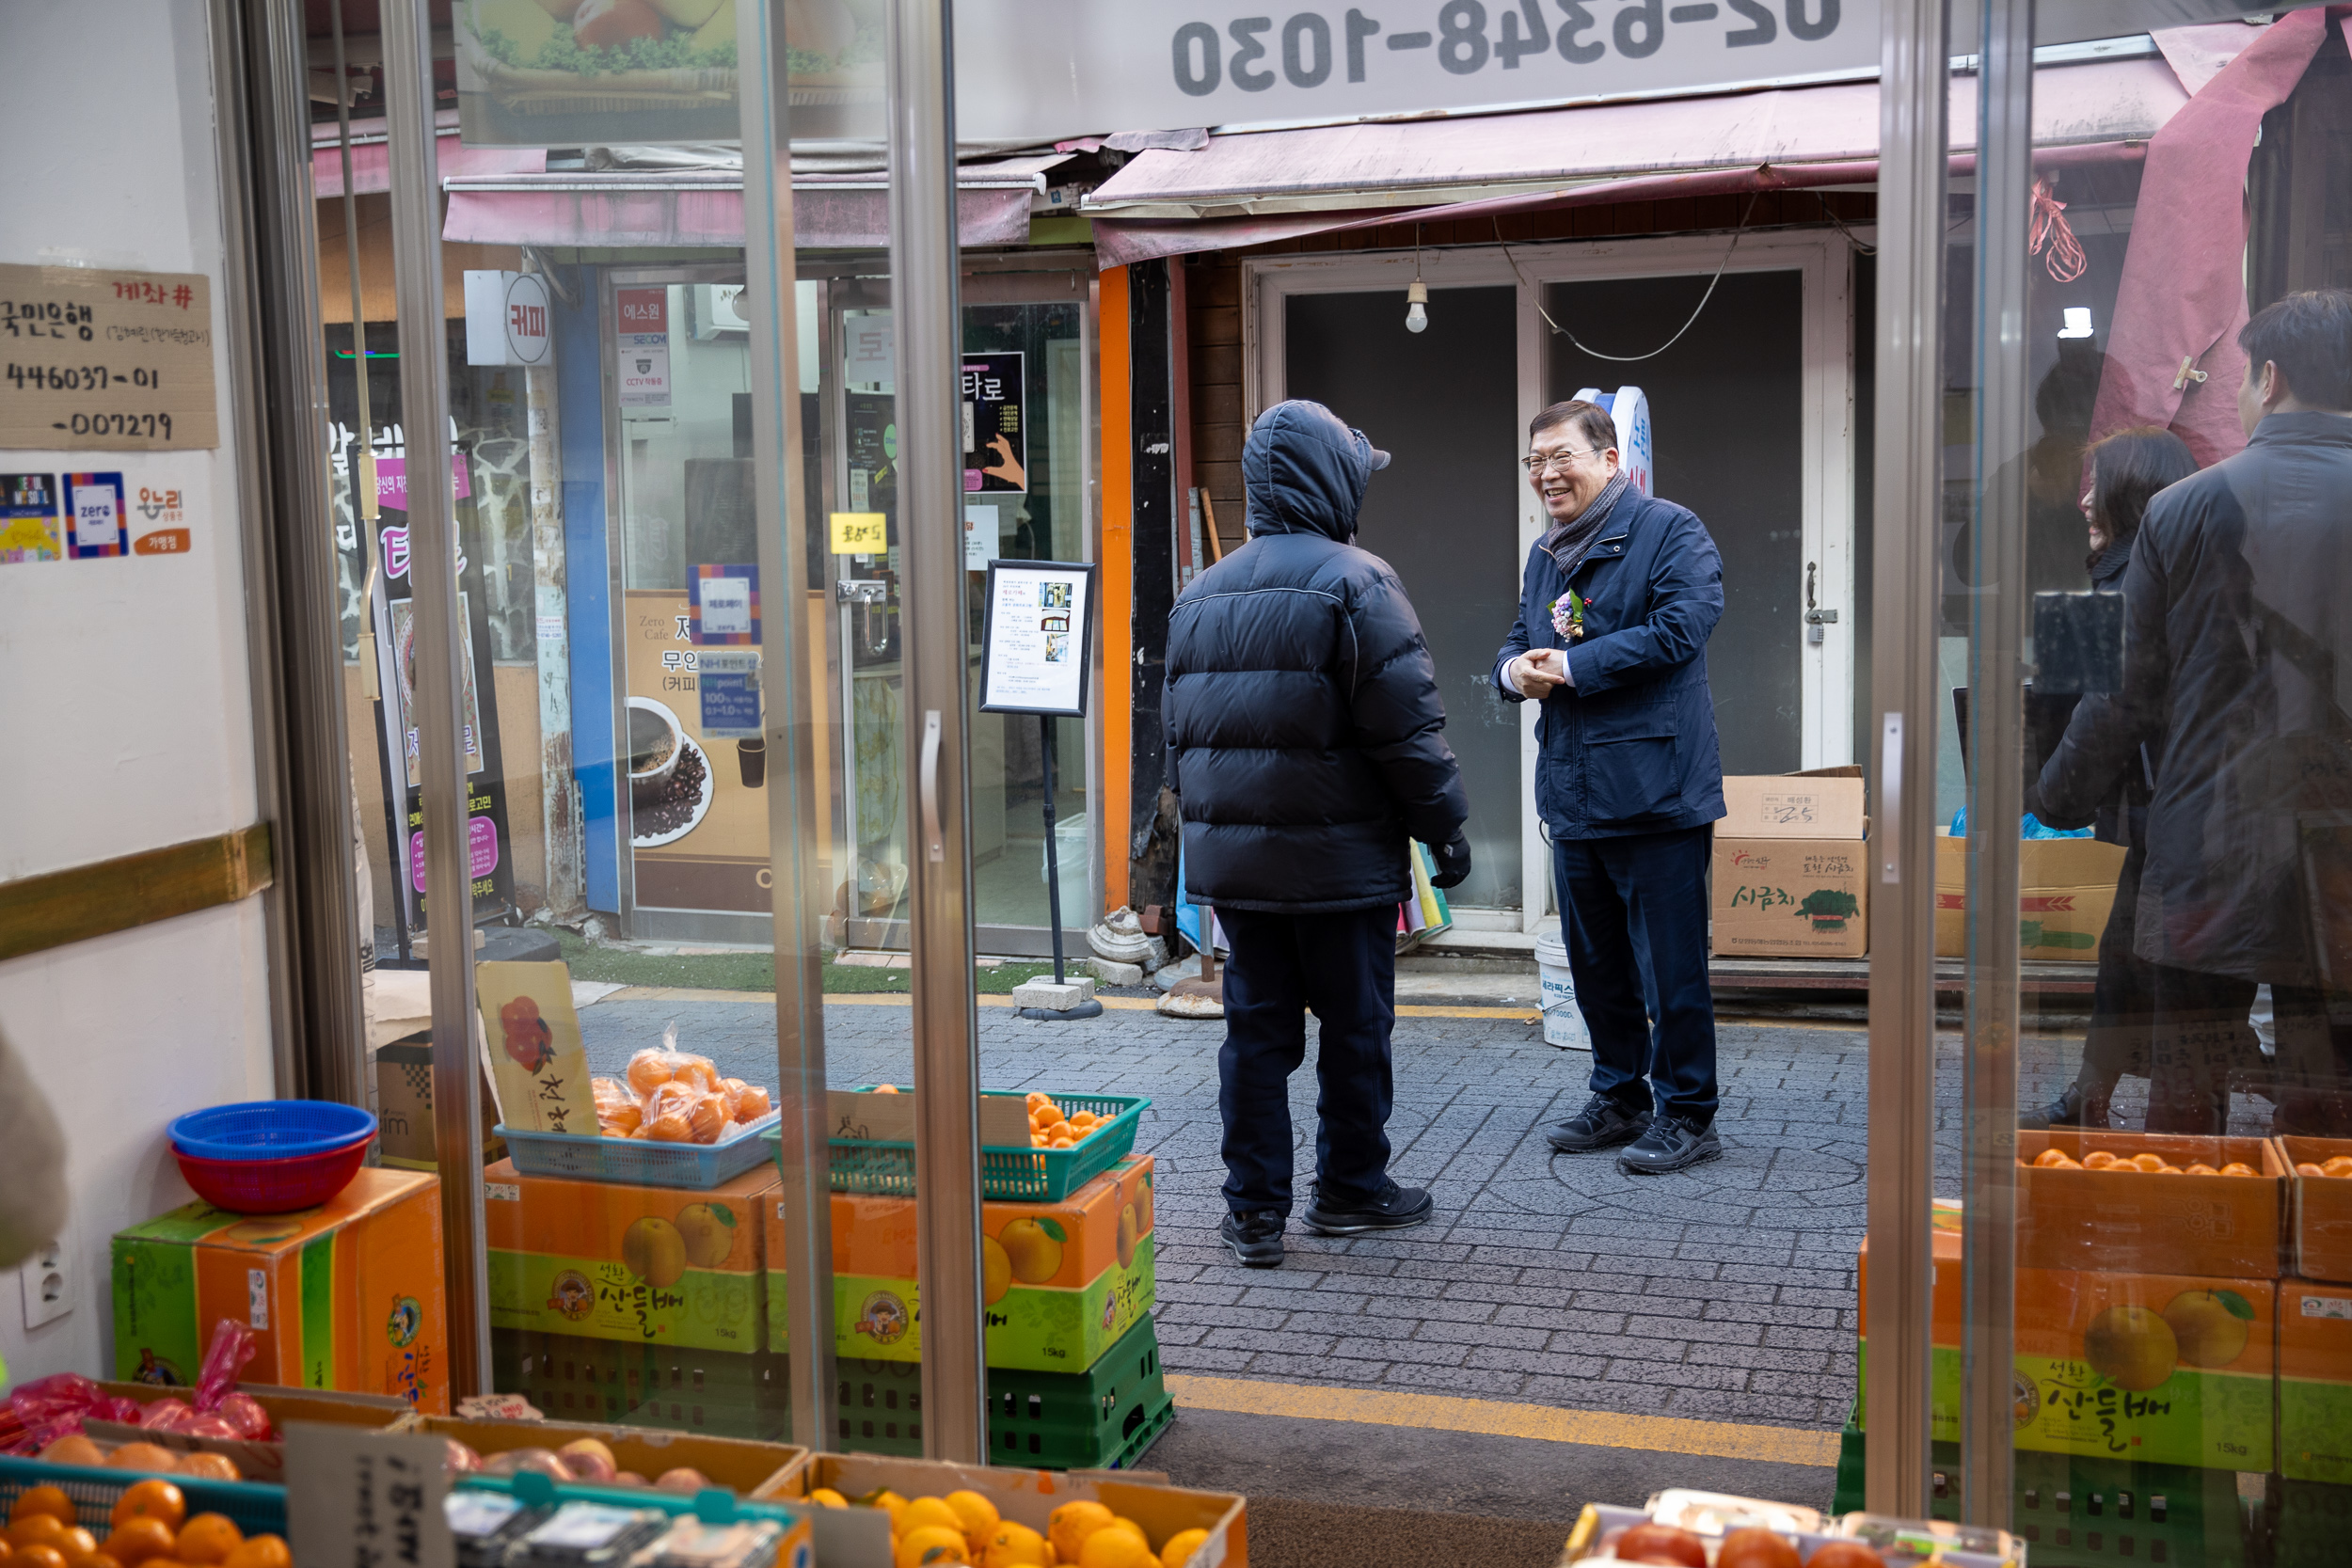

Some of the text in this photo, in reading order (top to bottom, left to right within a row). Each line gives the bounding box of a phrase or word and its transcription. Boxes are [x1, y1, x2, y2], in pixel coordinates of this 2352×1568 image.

[112, 281, 168, 304] 계좌
[624, 304, 660, 320] 에스원
[1, 302, 93, 341] 국민은행
[511, 305, 546, 338] 커피
[634, 334, 667, 344] SECOM
[8, 363, 158, 390] 446037-01
[626, 377, 644, 387] CCTV
[961, 372, 1006, 401] 타로
[52, 413, 173, 440] -007279
[18, 476, 42, 490] SEOUL
[27, 490, 49, 504] SOUL
[81, 505, 110, 517] zero
[149, 536, 177, 550] 가맹점
[708, 599, 743, 610] 제로페이
[640, 615, 665, 627] Zero
[644, 628, 669, 641] Cafe
[1731, 886, 1794, 911] 시금치
[600, 1263, 626, 1281] 성환
[599, 1286, 684, 1338] 산들배
[715, 1328, 737, 1339] 15kg
[1041, 1347, 1066, 1358] 15kg
[2050, 1361, 2086, 1382] 성환
[2047, 1388, 2170, 1452] 산들배
[2216, 1441, 2248, 1455] 15kg
